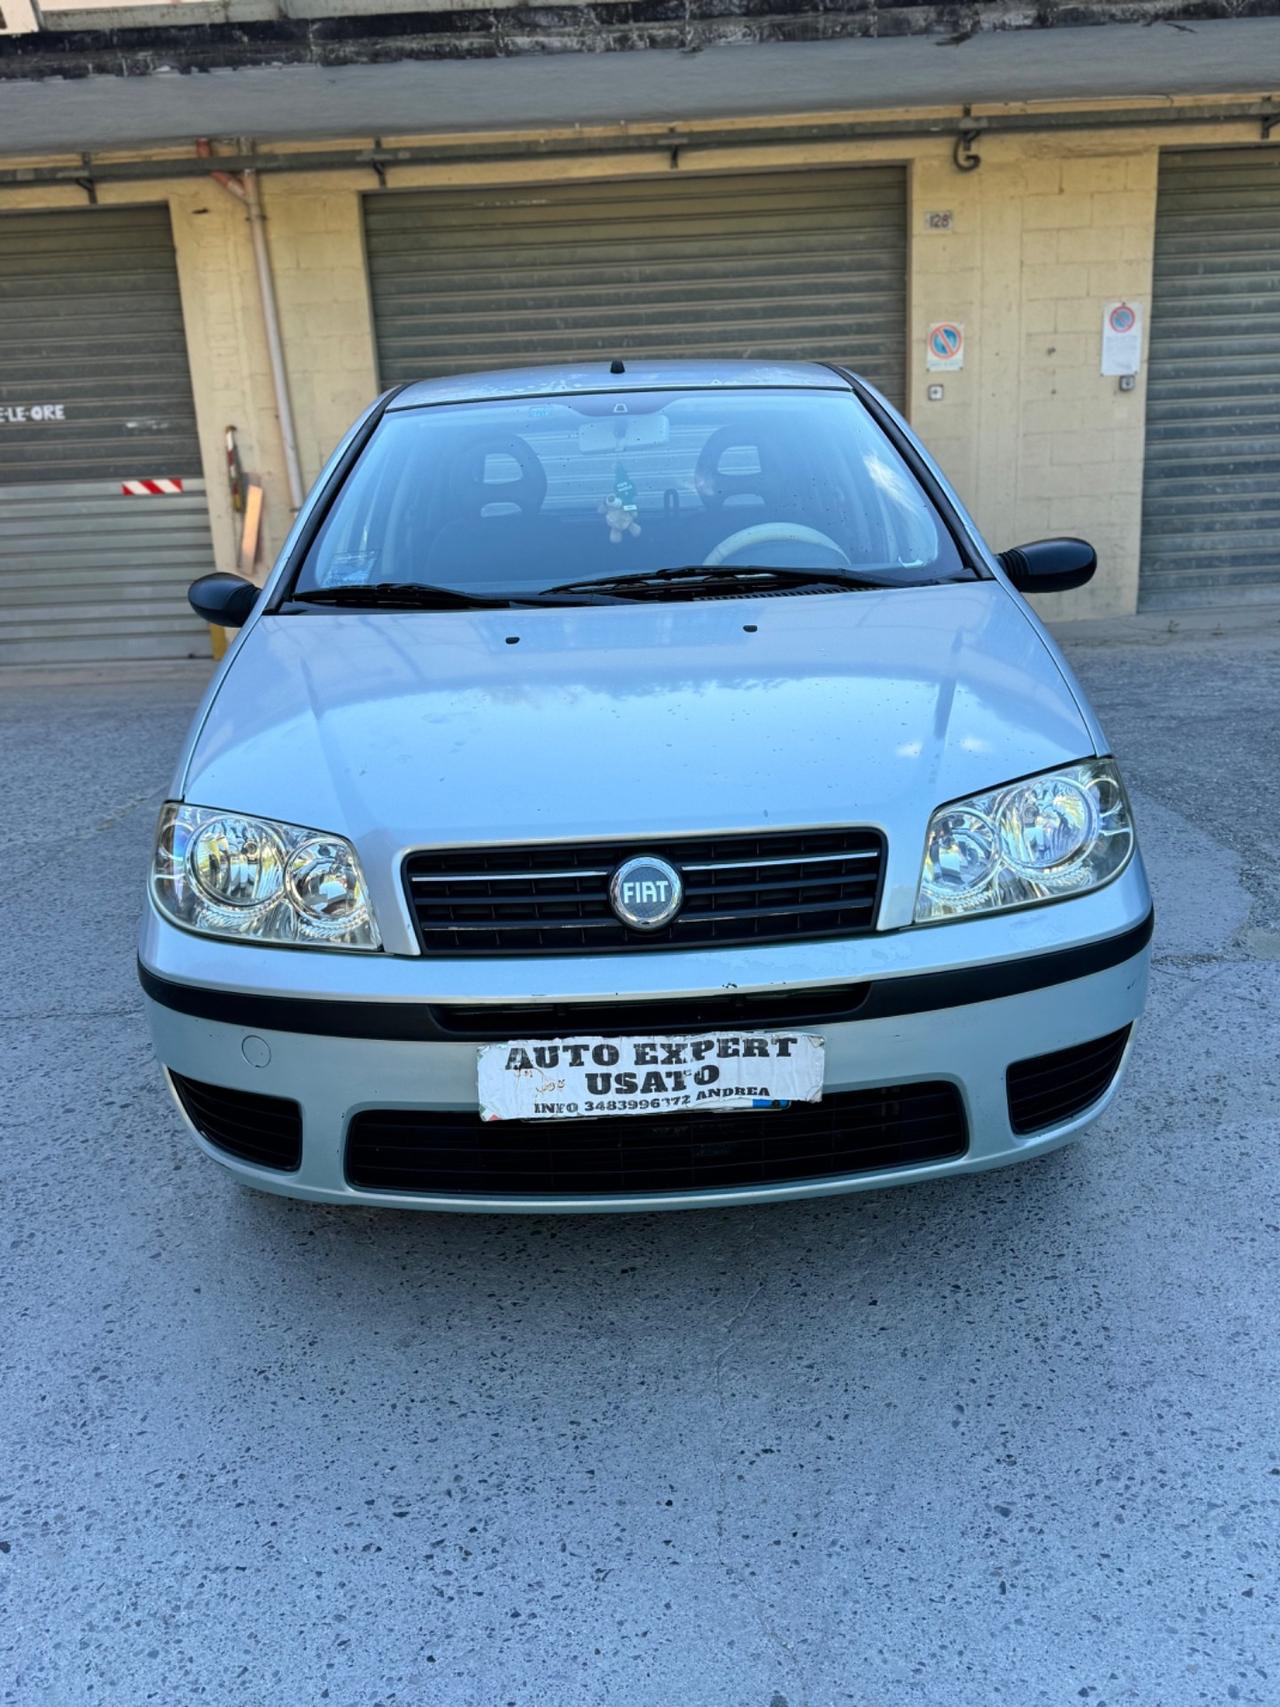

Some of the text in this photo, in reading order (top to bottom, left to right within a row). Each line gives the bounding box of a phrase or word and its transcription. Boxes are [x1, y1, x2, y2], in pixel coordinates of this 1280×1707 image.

[623, 880, 669, 904] FIAT
[505, 1037, 798, 1070] AUTO EXPERT
[585, 1064, 720, 1095] USATO
[534, 1102, 579, 1113] INFO
[696, 1087, 770, 1101] ANDREA
